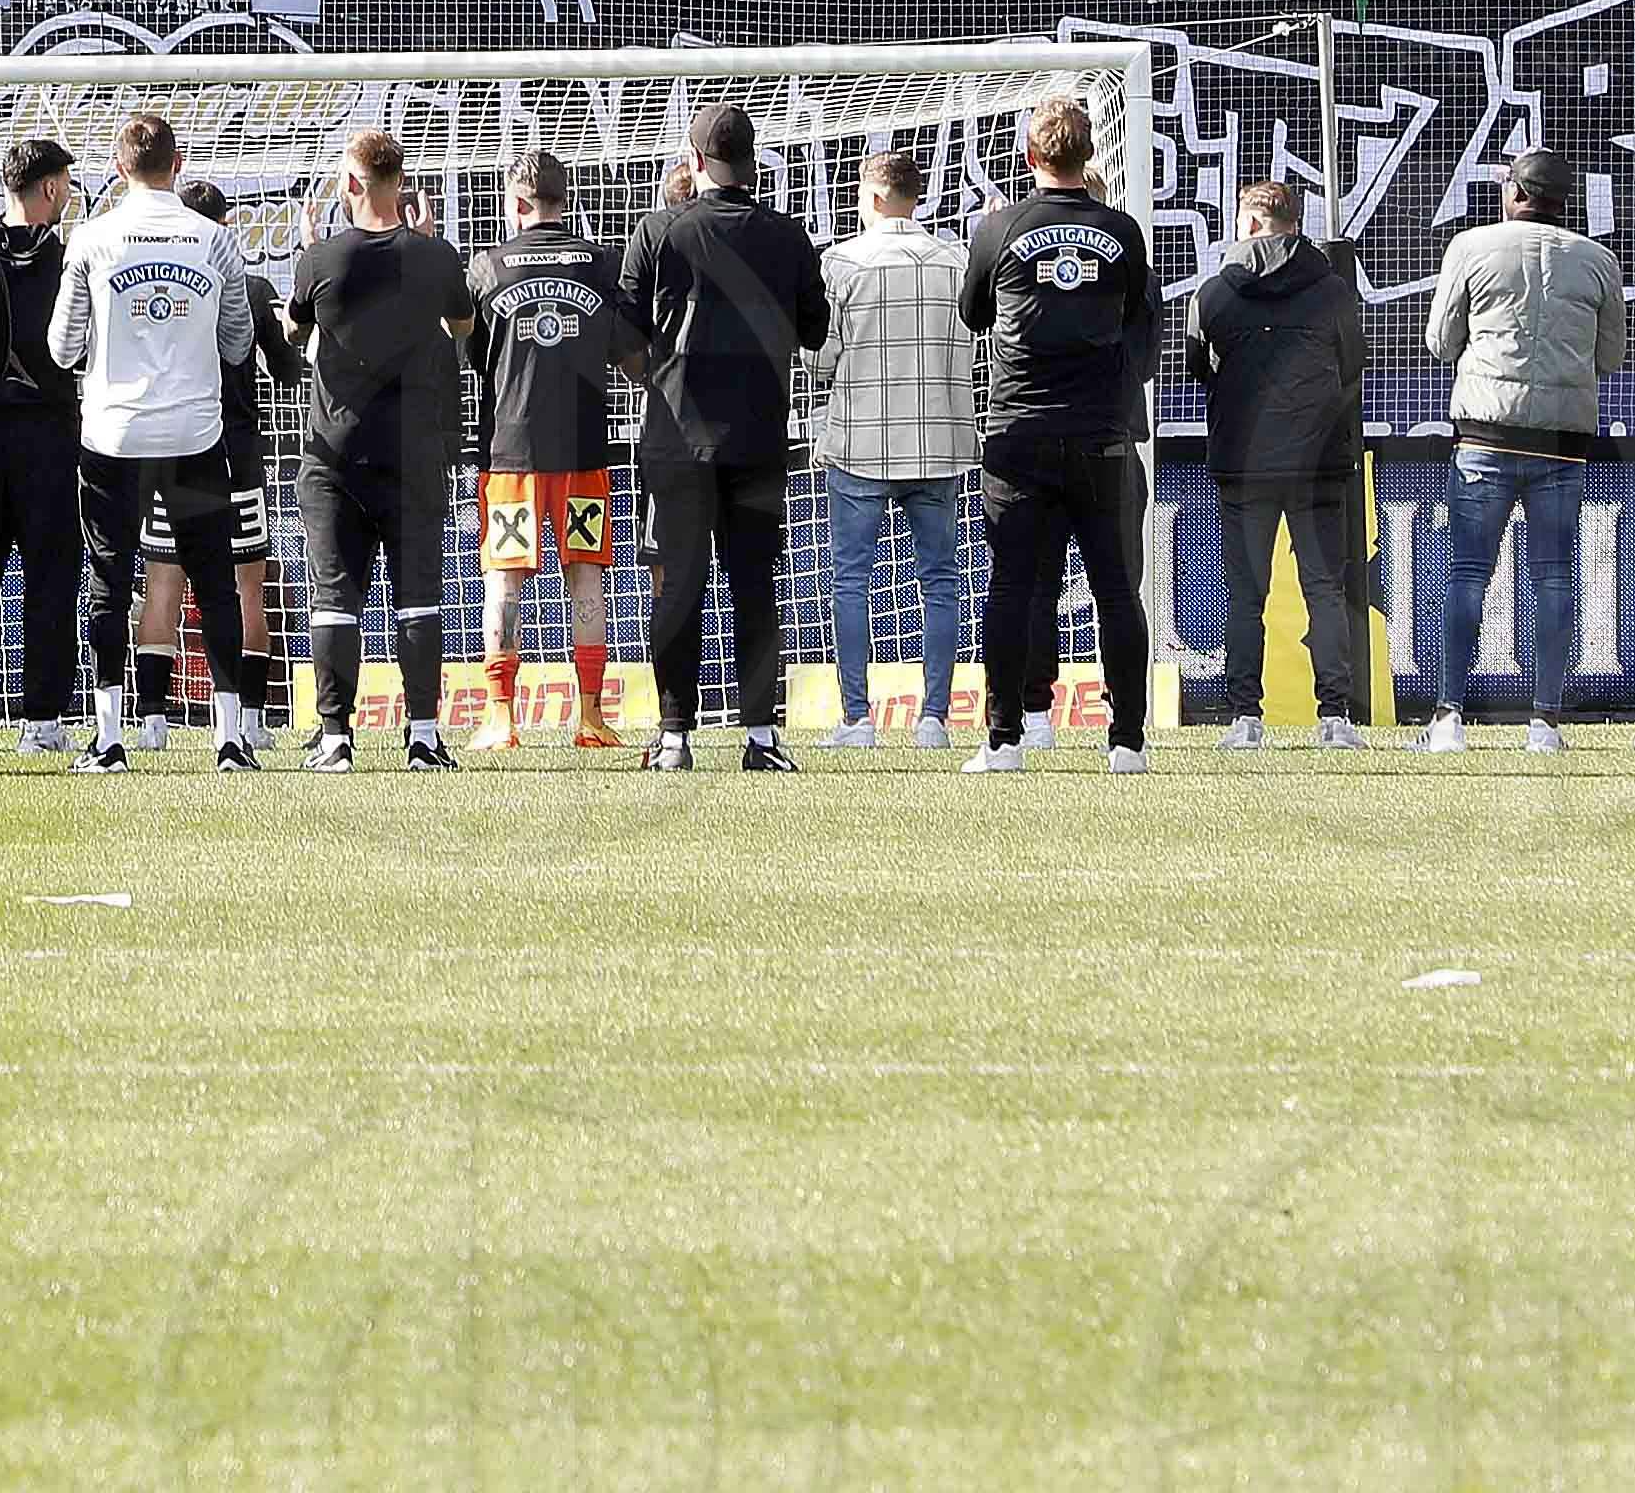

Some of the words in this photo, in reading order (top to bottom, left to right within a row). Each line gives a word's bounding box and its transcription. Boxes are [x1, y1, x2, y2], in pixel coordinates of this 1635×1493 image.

[1010, 223, 1123, 263] PUNTIGAMER
[110, 260, 213, 296] PUNTIGAMER
[492, 276, 603, 318] PUNTIGAMER
